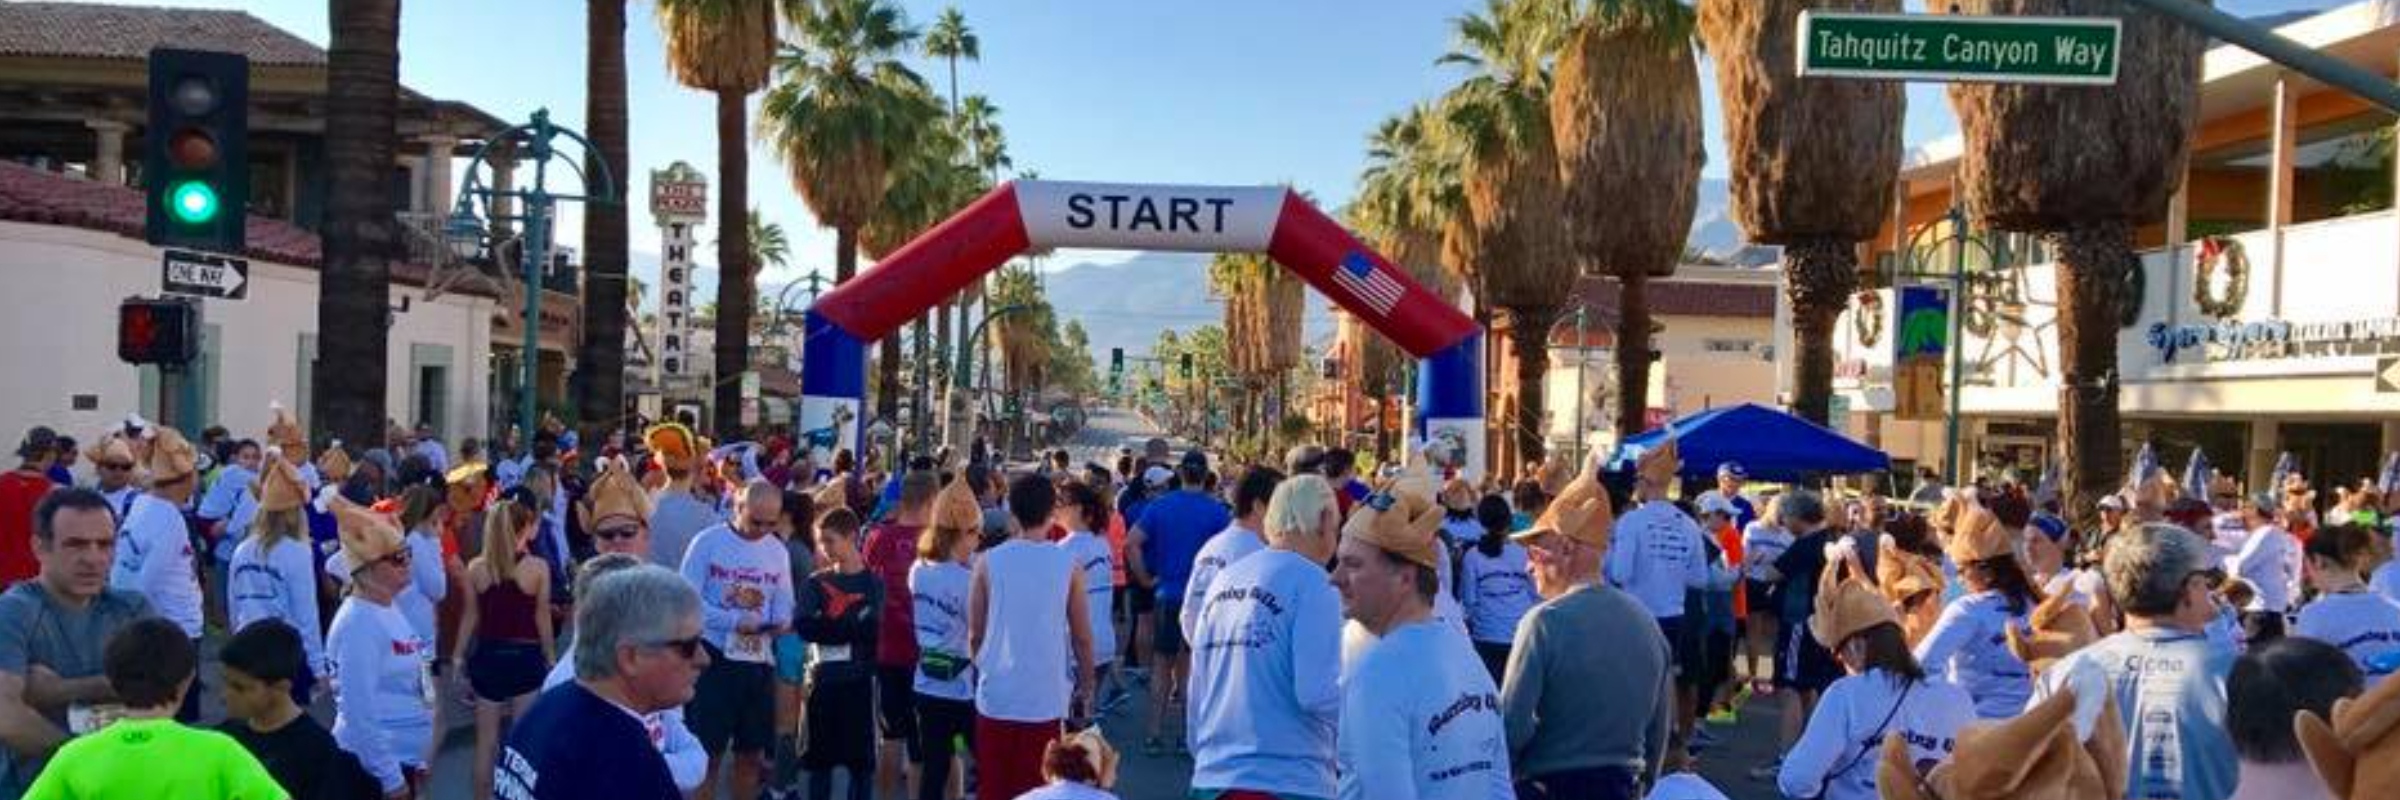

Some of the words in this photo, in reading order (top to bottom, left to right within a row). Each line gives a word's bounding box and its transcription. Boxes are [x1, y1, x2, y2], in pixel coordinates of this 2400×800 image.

[1817, 30, 1927, 65] Tahquitz
[1943, 33, 2038, 69] Canyon
[2054, 35, 2107, 72] Way
[1066, 193, 1234, 233] START
[664, 222, 685, 373] THEATRE
